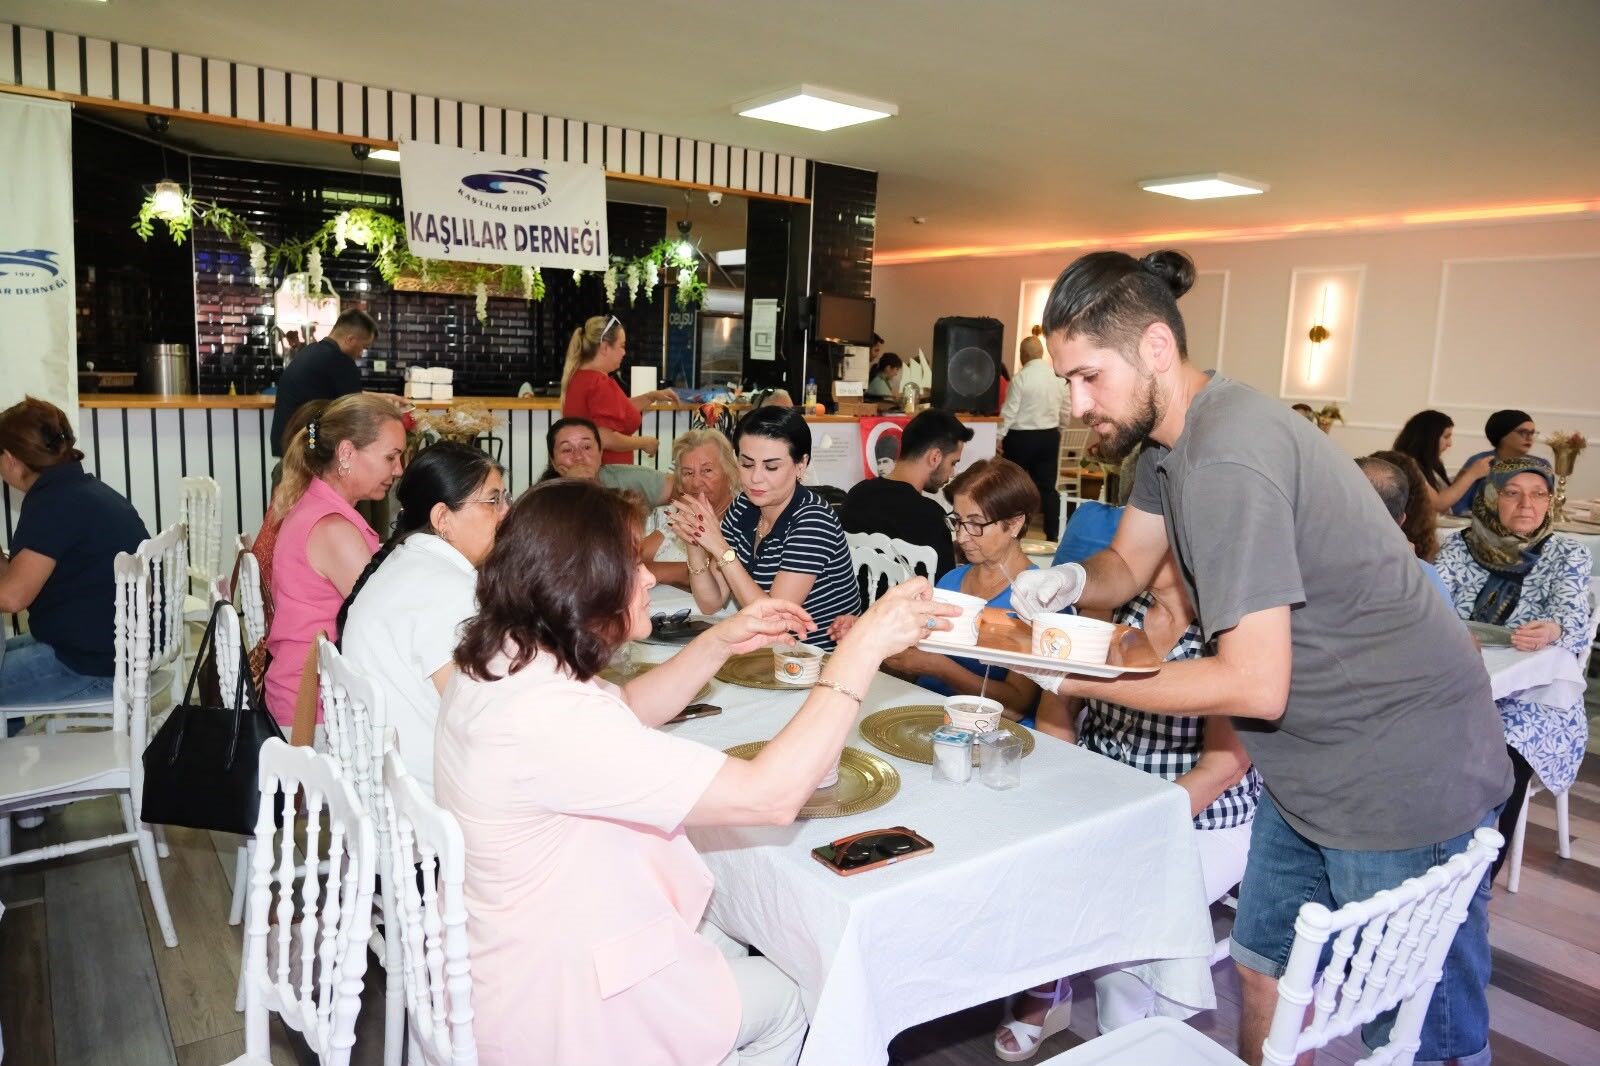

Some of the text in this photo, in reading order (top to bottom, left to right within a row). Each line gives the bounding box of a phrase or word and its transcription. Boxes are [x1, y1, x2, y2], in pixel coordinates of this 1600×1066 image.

[457, 188, 508, 211] KAŞLILAR
[410, 211, 601, 257] KAŞLILAR DERNEĞİ
